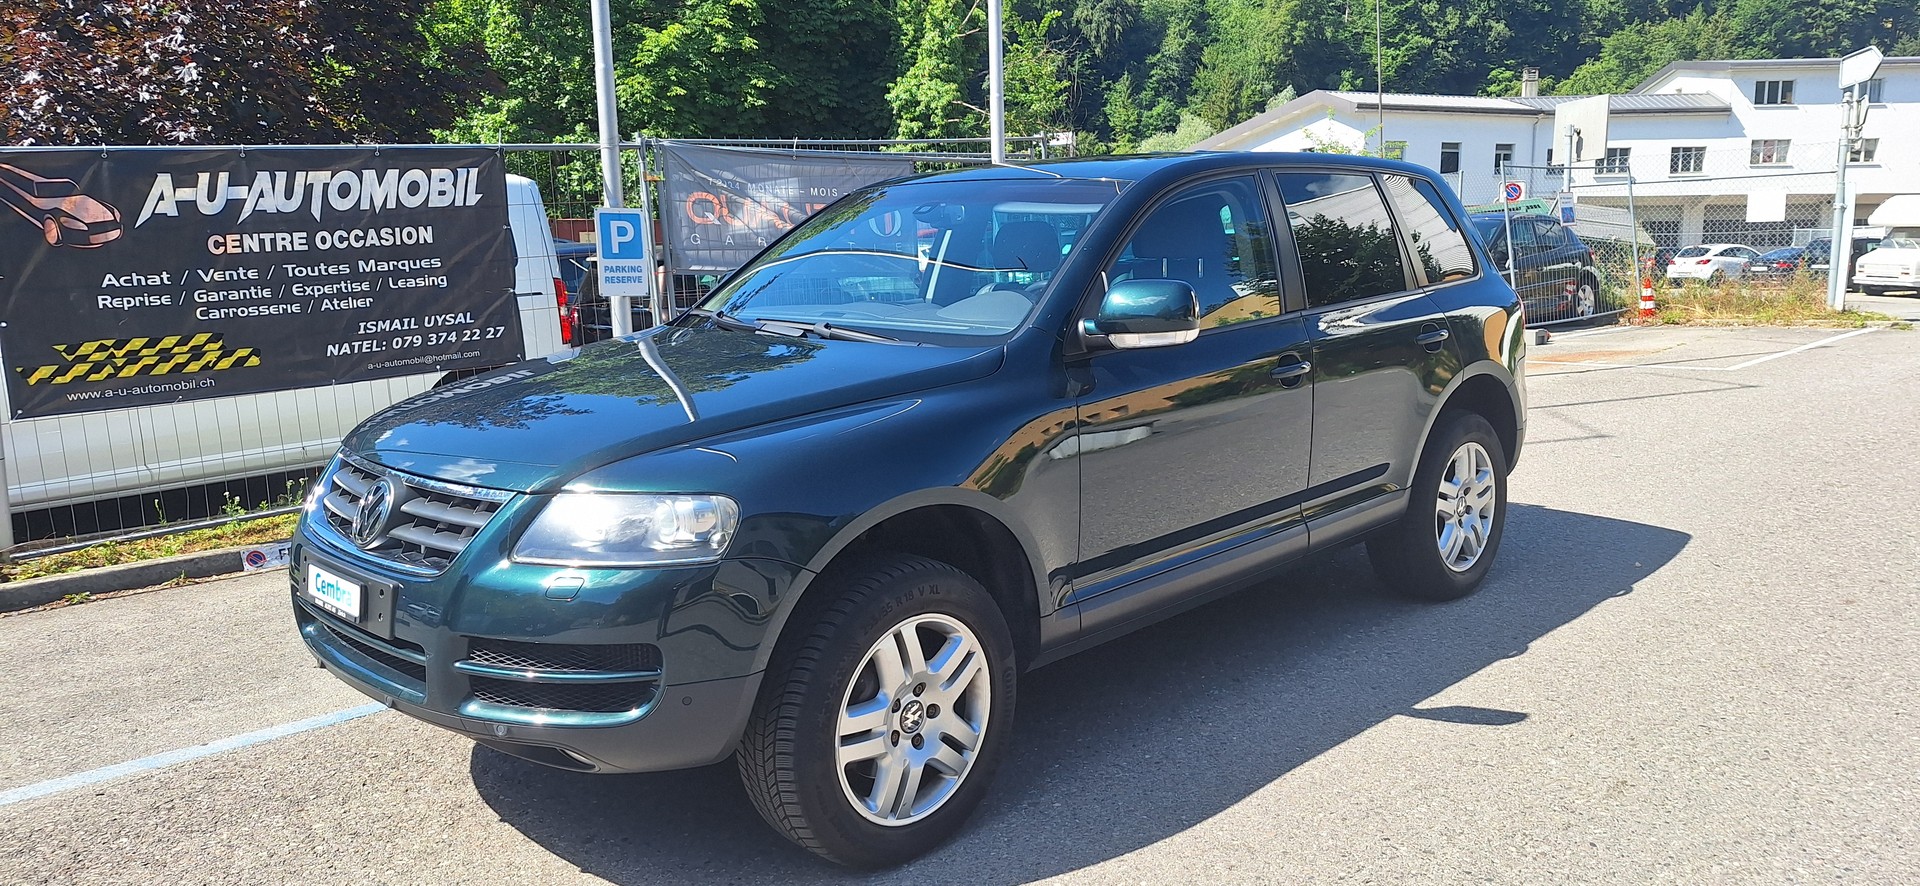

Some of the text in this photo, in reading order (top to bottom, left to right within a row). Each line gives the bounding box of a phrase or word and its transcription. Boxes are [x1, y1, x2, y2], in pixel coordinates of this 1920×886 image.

[135, 168, 484, 229] A-U-AUTOMOBIL
[747, 182, 795, 195] MONATE
[810, 187, 838, 197] MOIS
[207, 226, 434, 255] CENTRE OCCASION
[609, 220, 635, 254] P
[101, 257, 442, 288] Achat / Vente / Toutes Marques
[604, 265, 643, 273] PARKING
[604, 276, 643, 284] RESERVE
[97, 274, 448, 310] Reprise / Garantie / Expertise / Leasing
[195, 297, 373, 320] Carrosserie / Atelier
[358, 311, 475, 335] ISMAIL UYSAL
[326, 326, 505, 357] NATEL: 079 374 22 27
[367, 350, 480, 370] a-u-automobil@hotmail.com
[66, 377, 216, 401] www.a-u-automobil.ch
[315, 572, 352, 608] Cembra
[904, 590, 914, 602] 18
[928, 584, 941, 595] XL
